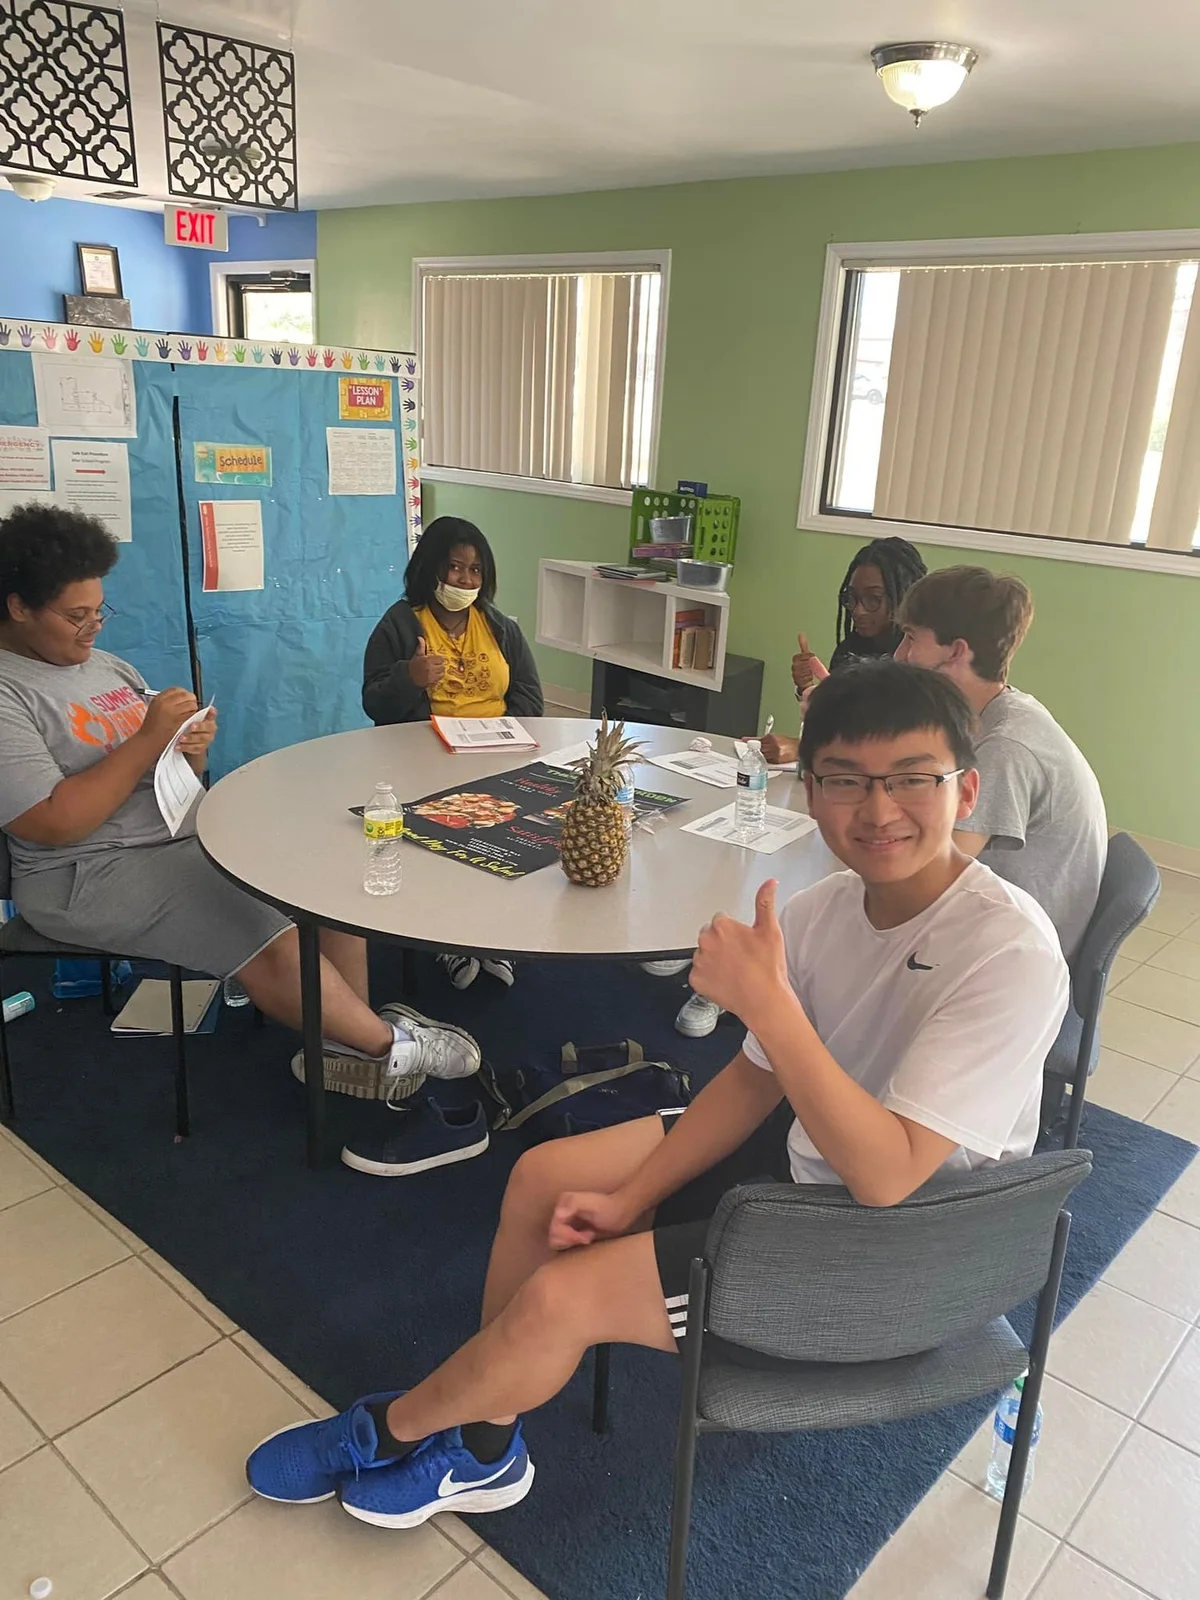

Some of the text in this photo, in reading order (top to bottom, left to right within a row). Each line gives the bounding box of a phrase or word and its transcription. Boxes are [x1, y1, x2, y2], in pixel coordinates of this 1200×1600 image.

[176, 209, 216, 245] EXIT
[352, 386, 380, 396] LESSON
[356, 395, 377, 406] PLAN
[219, 455, 263, 467] Schedule
[89, 686, 140, 712] SUMME
